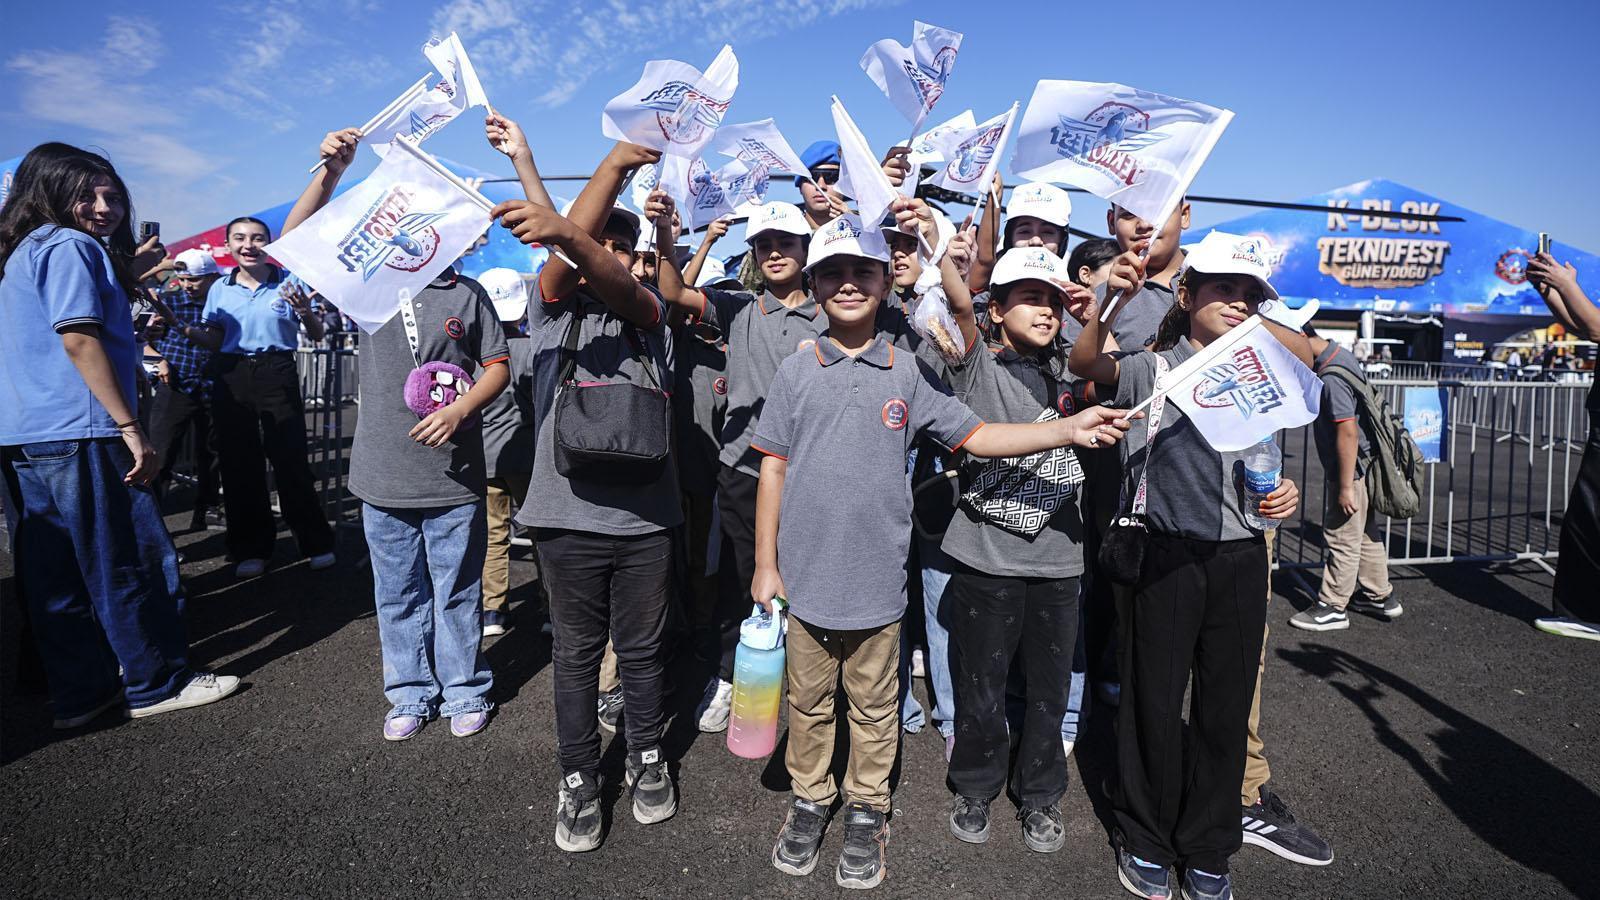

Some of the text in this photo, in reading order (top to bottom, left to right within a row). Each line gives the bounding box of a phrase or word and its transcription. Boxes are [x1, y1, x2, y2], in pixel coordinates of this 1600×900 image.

[337, 186, 416, 272] TEKNOFEST
[1327, 198, 1441, 234] K-BLOK
[1317, 238, 1451, 266] TEKNOFEST
